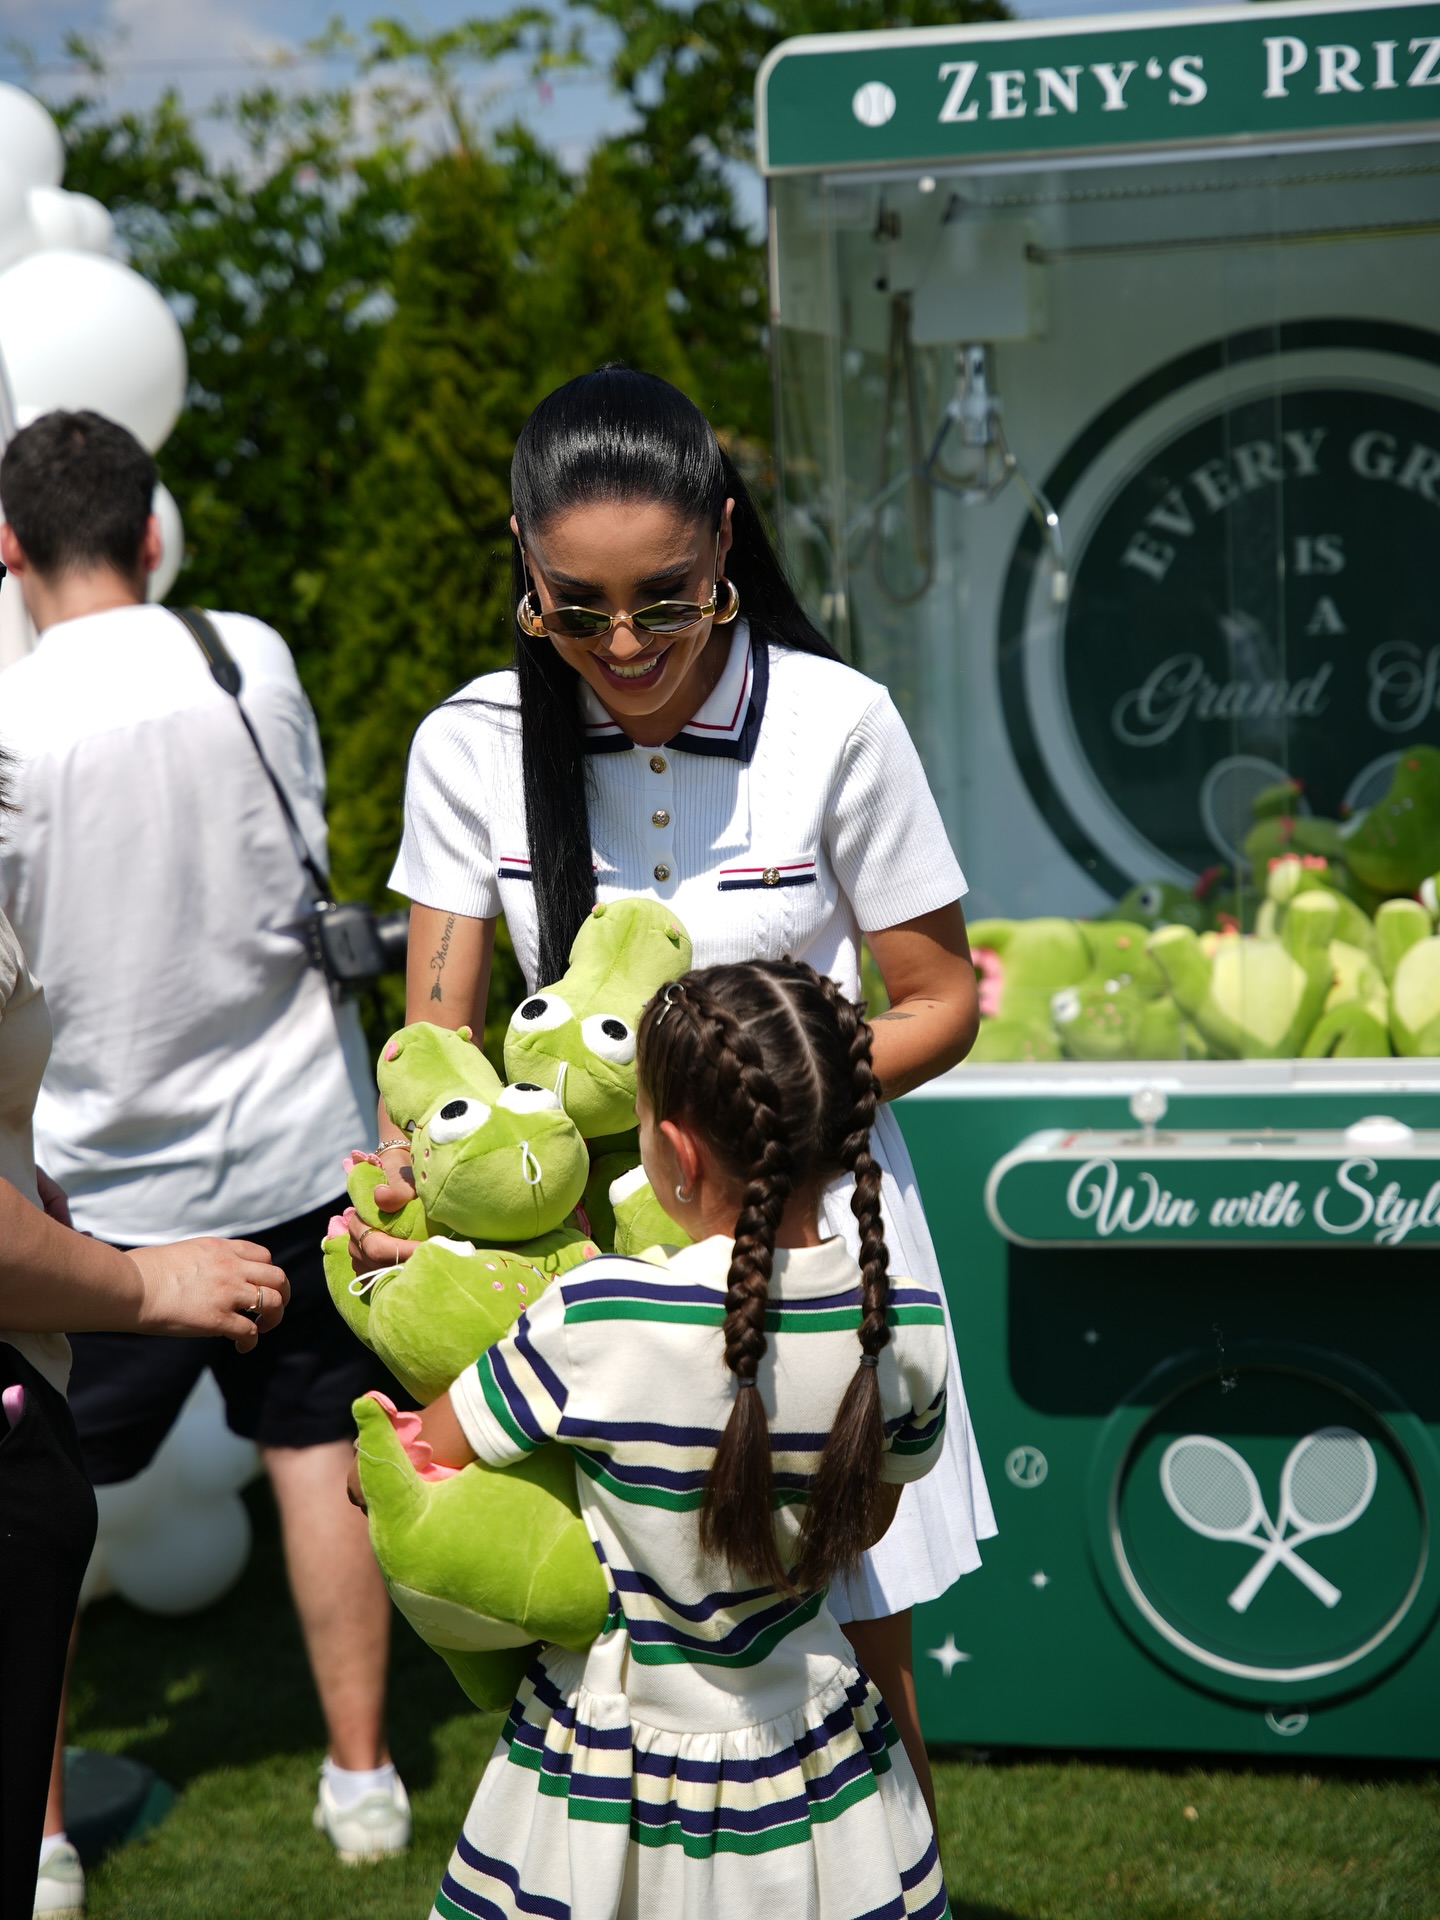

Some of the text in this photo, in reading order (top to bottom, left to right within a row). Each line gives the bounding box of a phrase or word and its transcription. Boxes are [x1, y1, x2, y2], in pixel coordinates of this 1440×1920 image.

[1121, 427, 1328, 583] EVERY
[1293, 534, 1346, 576] IS
[1305, 596, 1347, 635] A
[1111, 652, 1334, 748] Grand
[1066, 1155, 1440, 1246] Win with Styl
